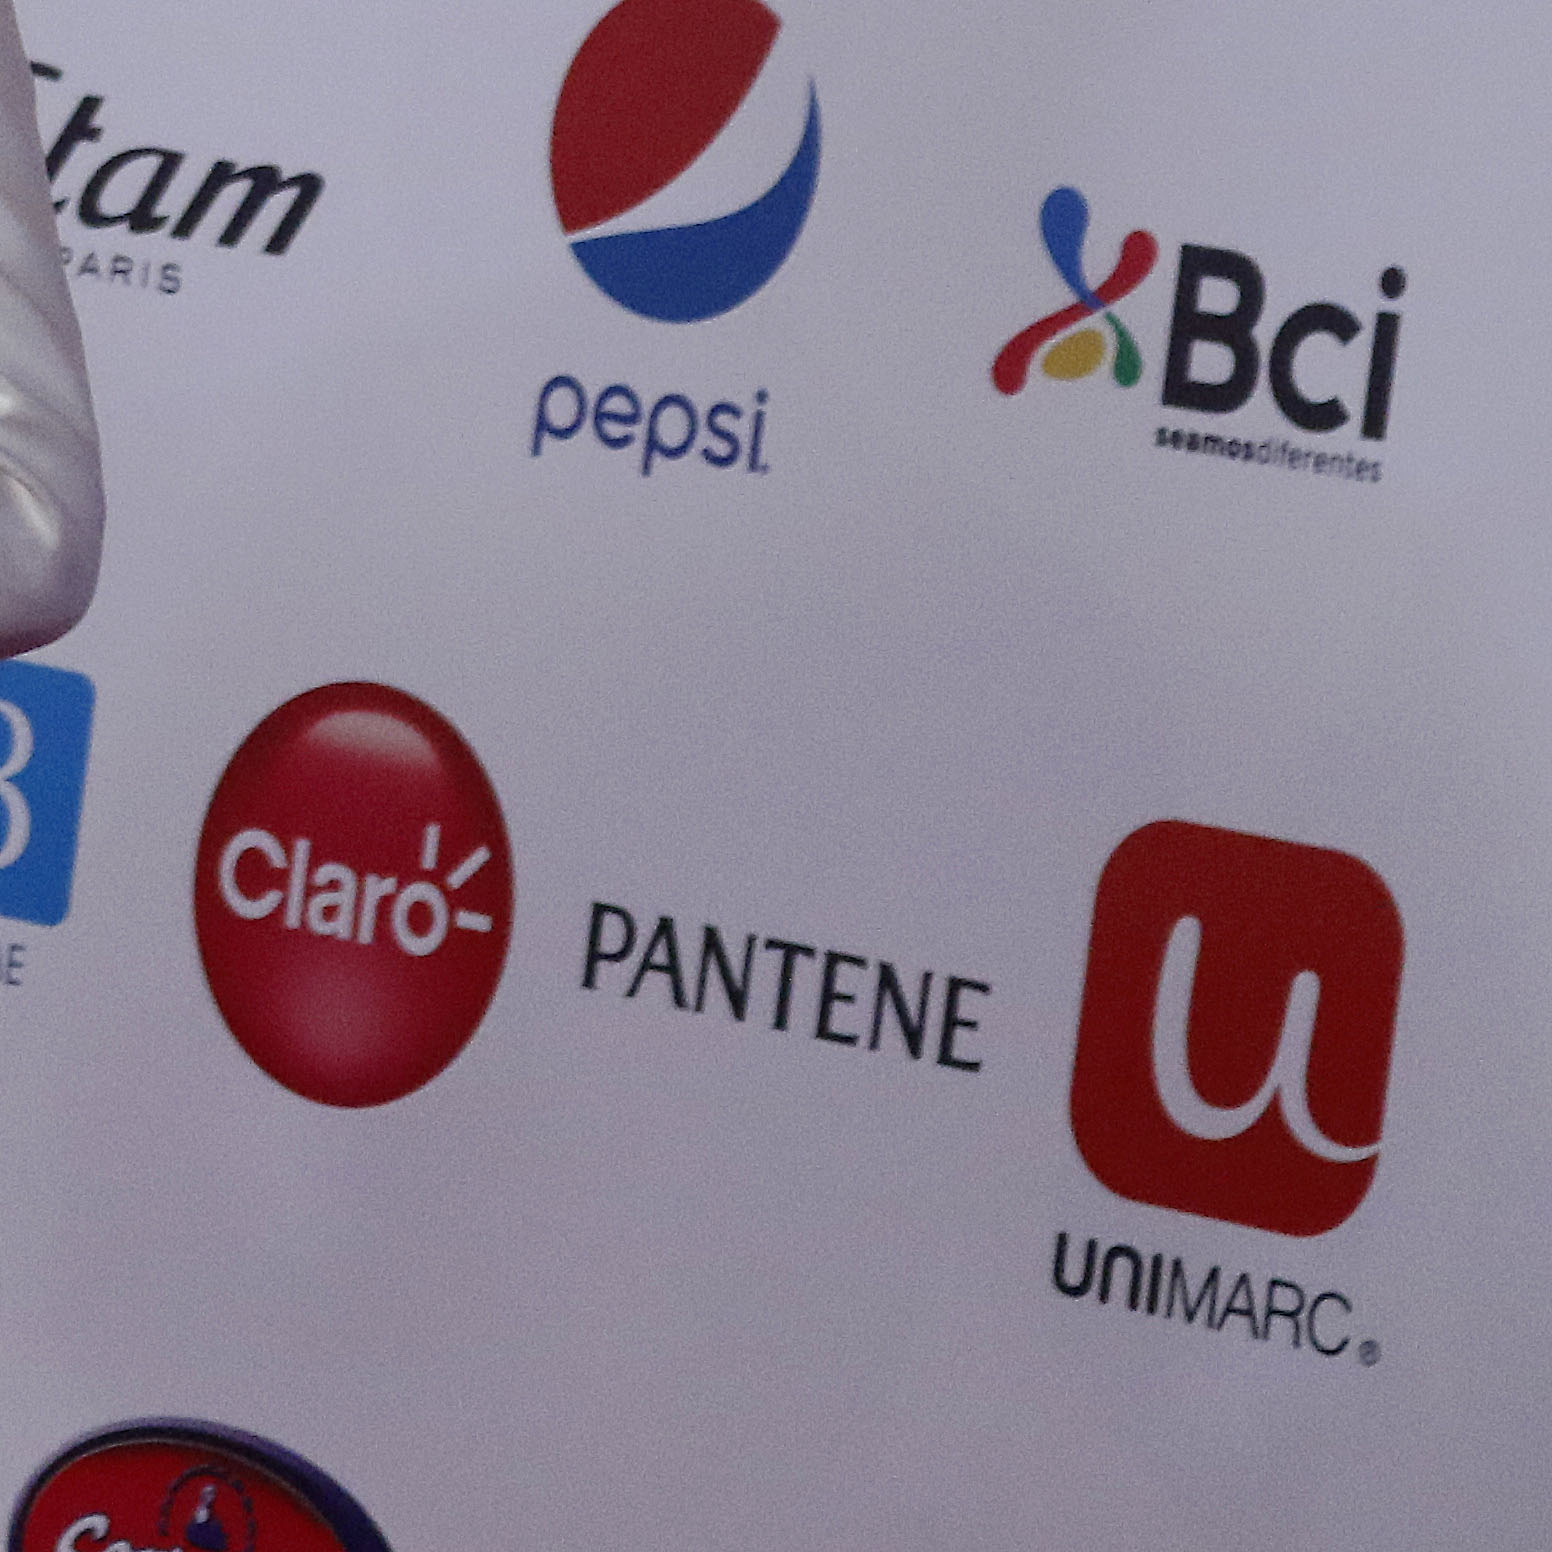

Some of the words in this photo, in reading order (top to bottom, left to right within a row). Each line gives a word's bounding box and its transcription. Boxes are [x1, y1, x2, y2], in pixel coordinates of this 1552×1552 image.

[29, 59, 326, 256] tam
[530, 374, 770, 477] pepsi
[1161, 243, 1408, 442] Bci
[217, 828, 450, 957] Claro
[580, 901, 992, 1073] PANTENE
